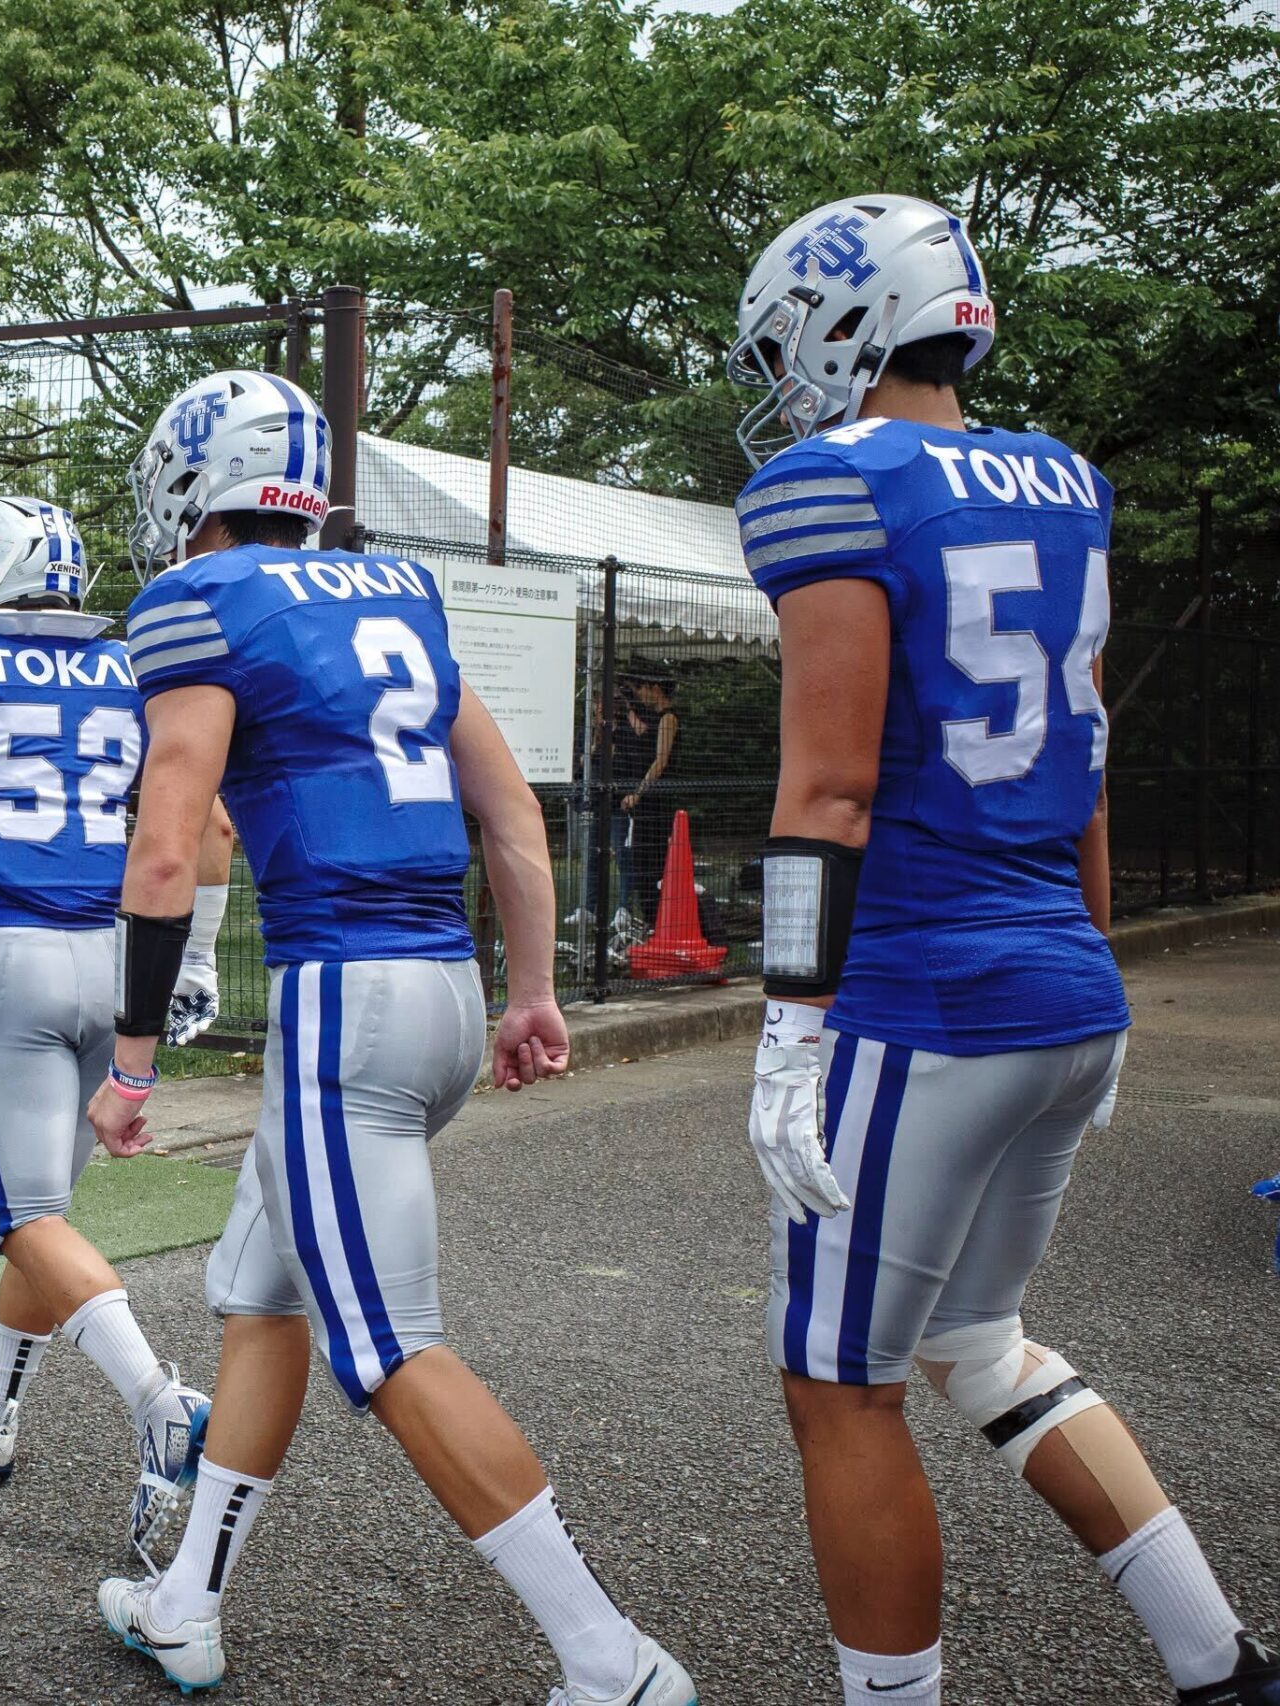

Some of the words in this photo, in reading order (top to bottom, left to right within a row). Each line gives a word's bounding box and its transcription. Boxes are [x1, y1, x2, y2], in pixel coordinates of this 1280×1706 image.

[921, 439, 1099, 508] TOKAI
[259, 486, 329, 521] Riddell
[50, 562, 81, 575] XENITH
[258, 560, 430, 601] TOKAI
[941, 540, 1111, 787] 54
[350, 616, 455, 804] 2
[119, 1073, 151, 1088] FOOTBALL
